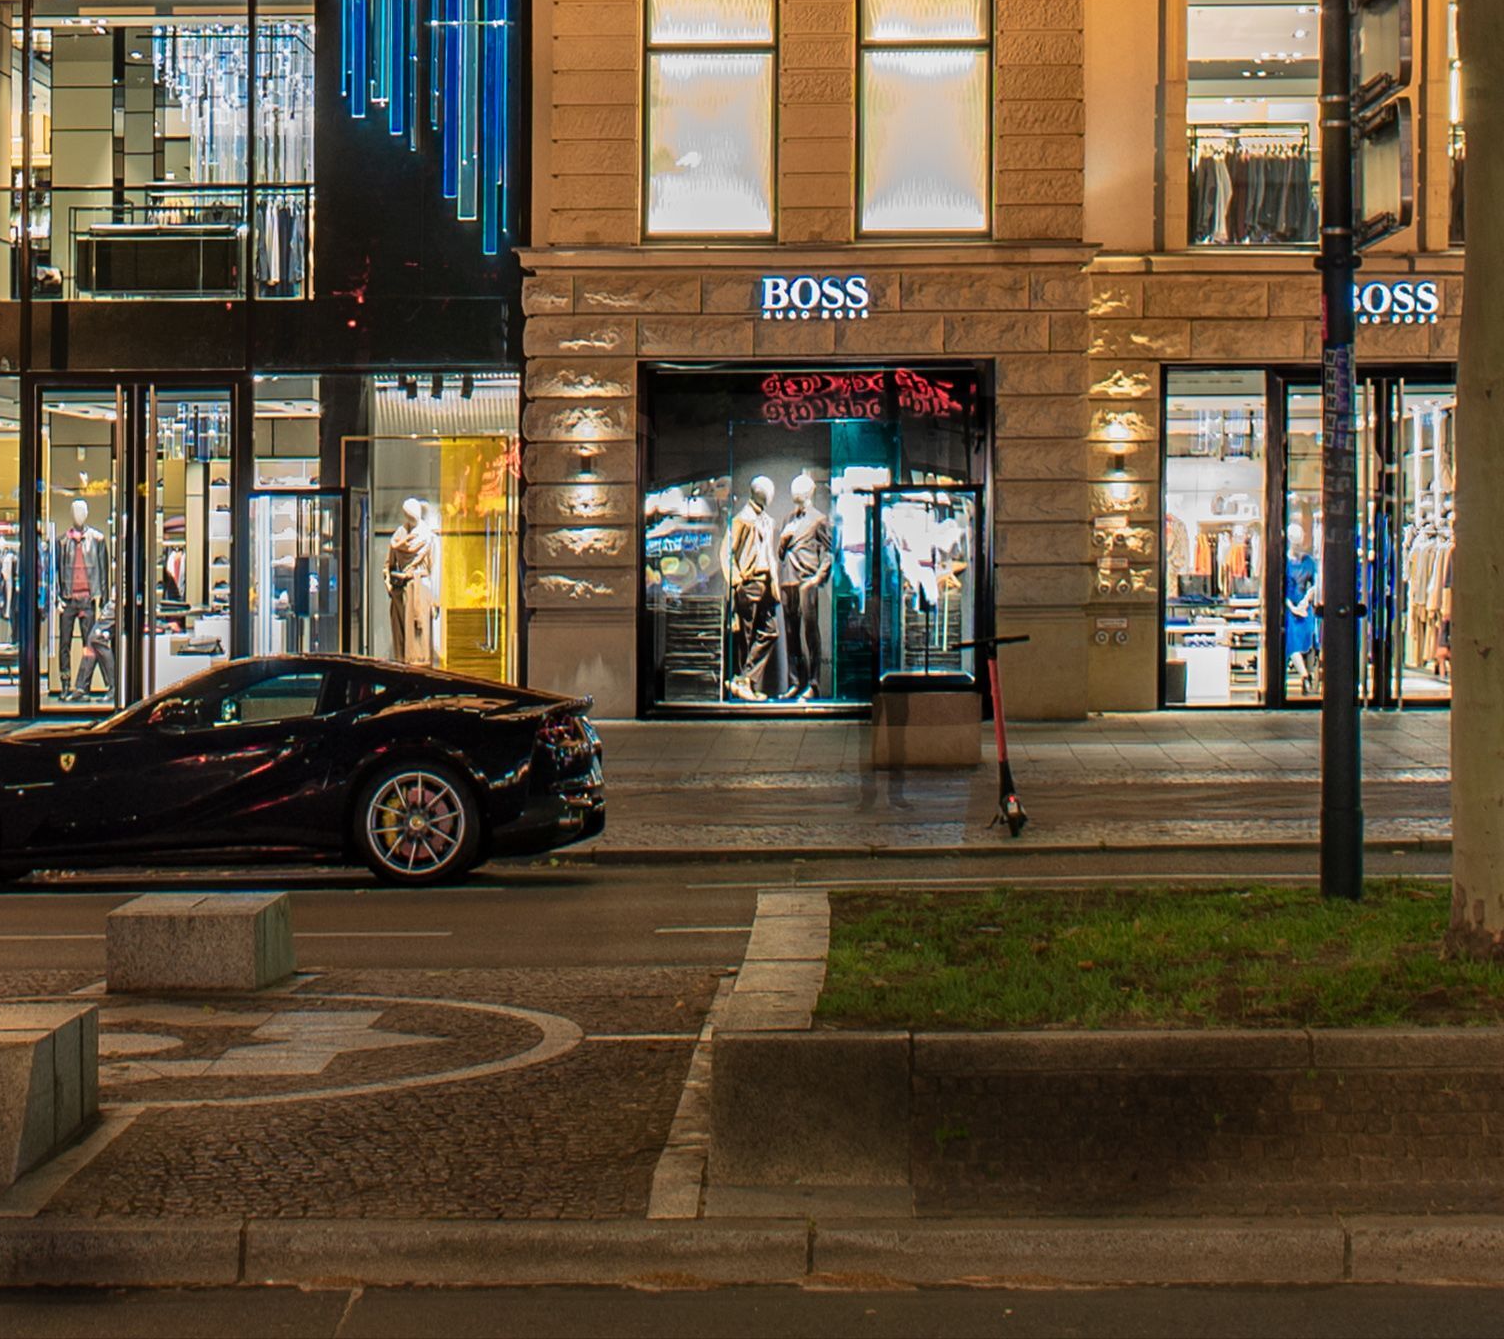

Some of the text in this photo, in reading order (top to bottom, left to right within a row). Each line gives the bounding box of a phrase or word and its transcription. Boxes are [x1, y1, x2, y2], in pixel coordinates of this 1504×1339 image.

[761, 276, 869, 309] BOSS
[761, 309, 869, 320] HUGO BOSS
